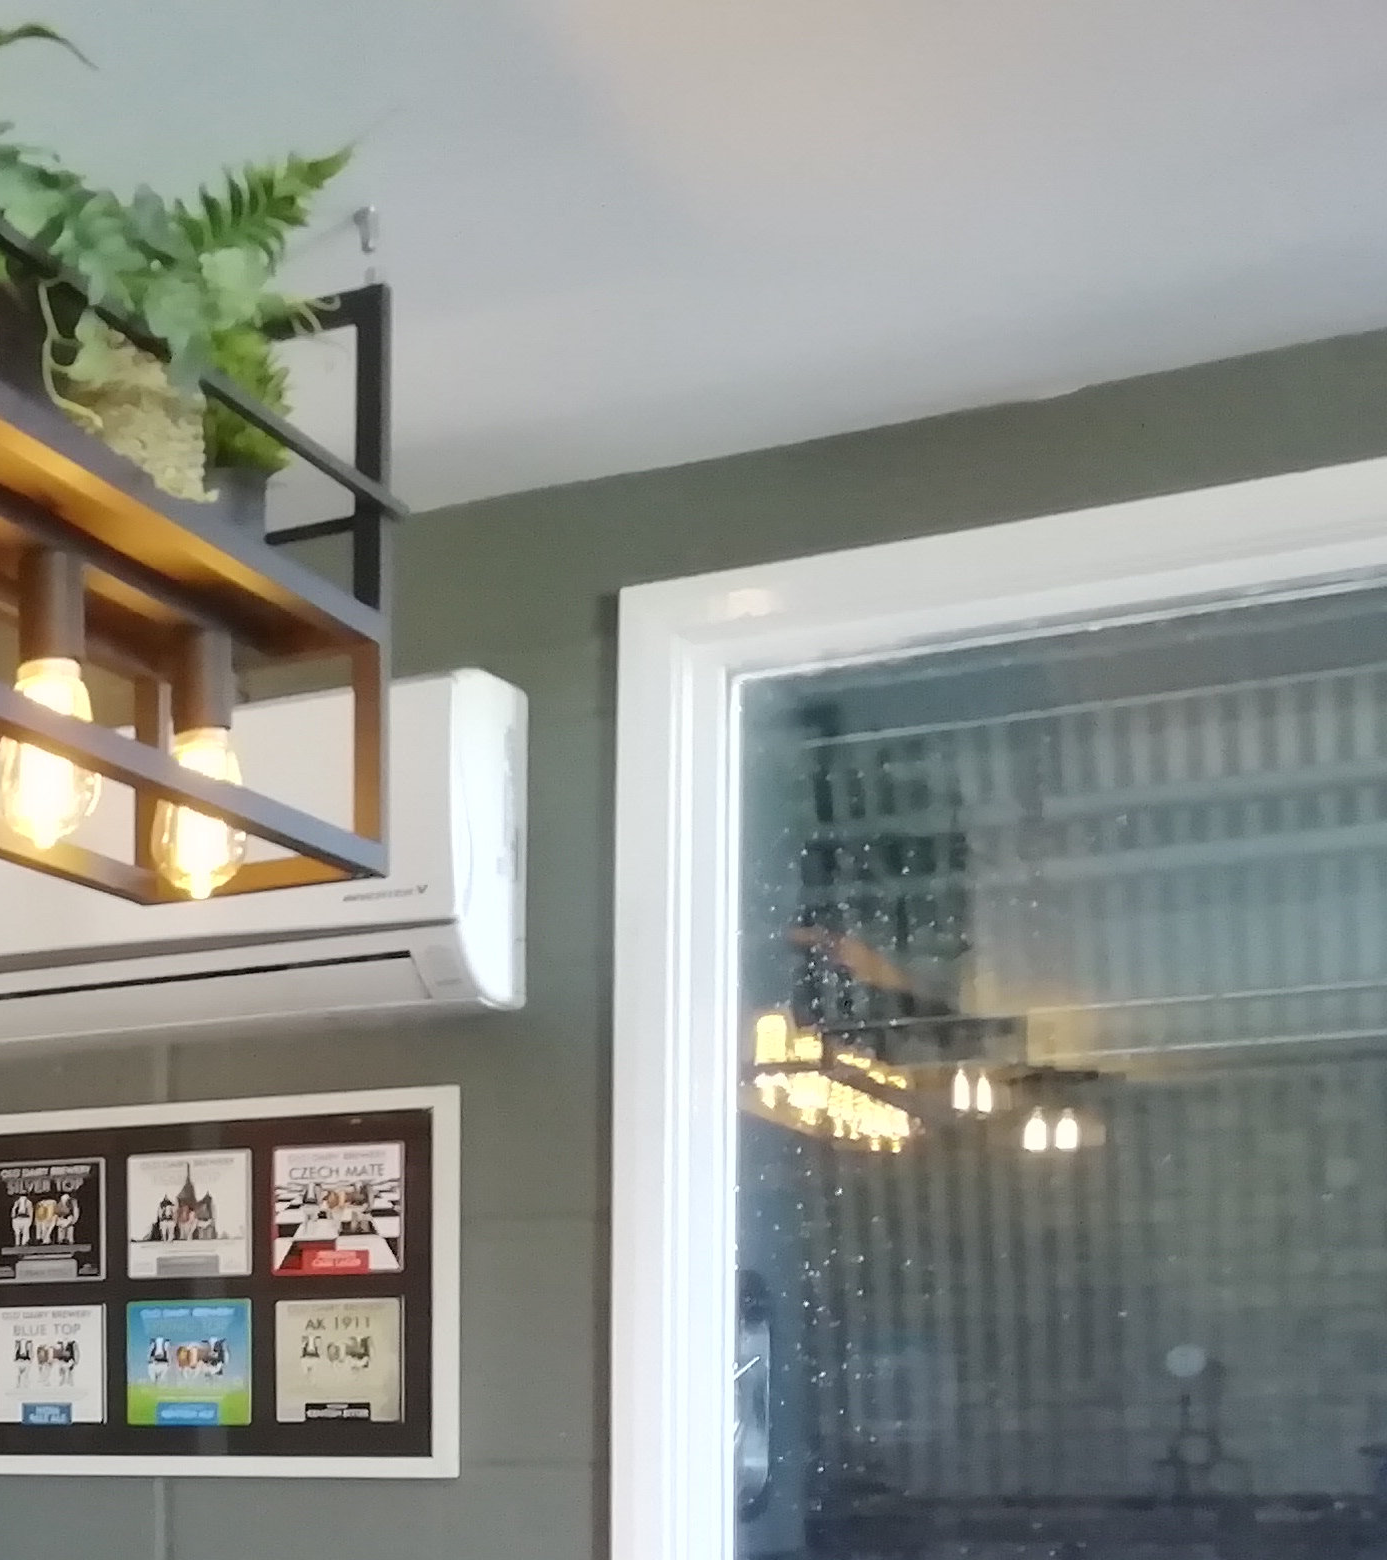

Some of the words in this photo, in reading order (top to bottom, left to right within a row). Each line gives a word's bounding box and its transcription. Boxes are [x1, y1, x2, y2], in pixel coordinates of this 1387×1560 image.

[289, 1165, 340, 1181] CZECH
[345, 1163, 385, 1178] MATE
[54, 1176, 85, 1192] TOP
[13, 1324, 48, 1337] BLUE
[53, 1323, 82, 1336] TOP
[305, 1317, 326, 1331] AK
[334, 1315, 371, 1330] 1911
